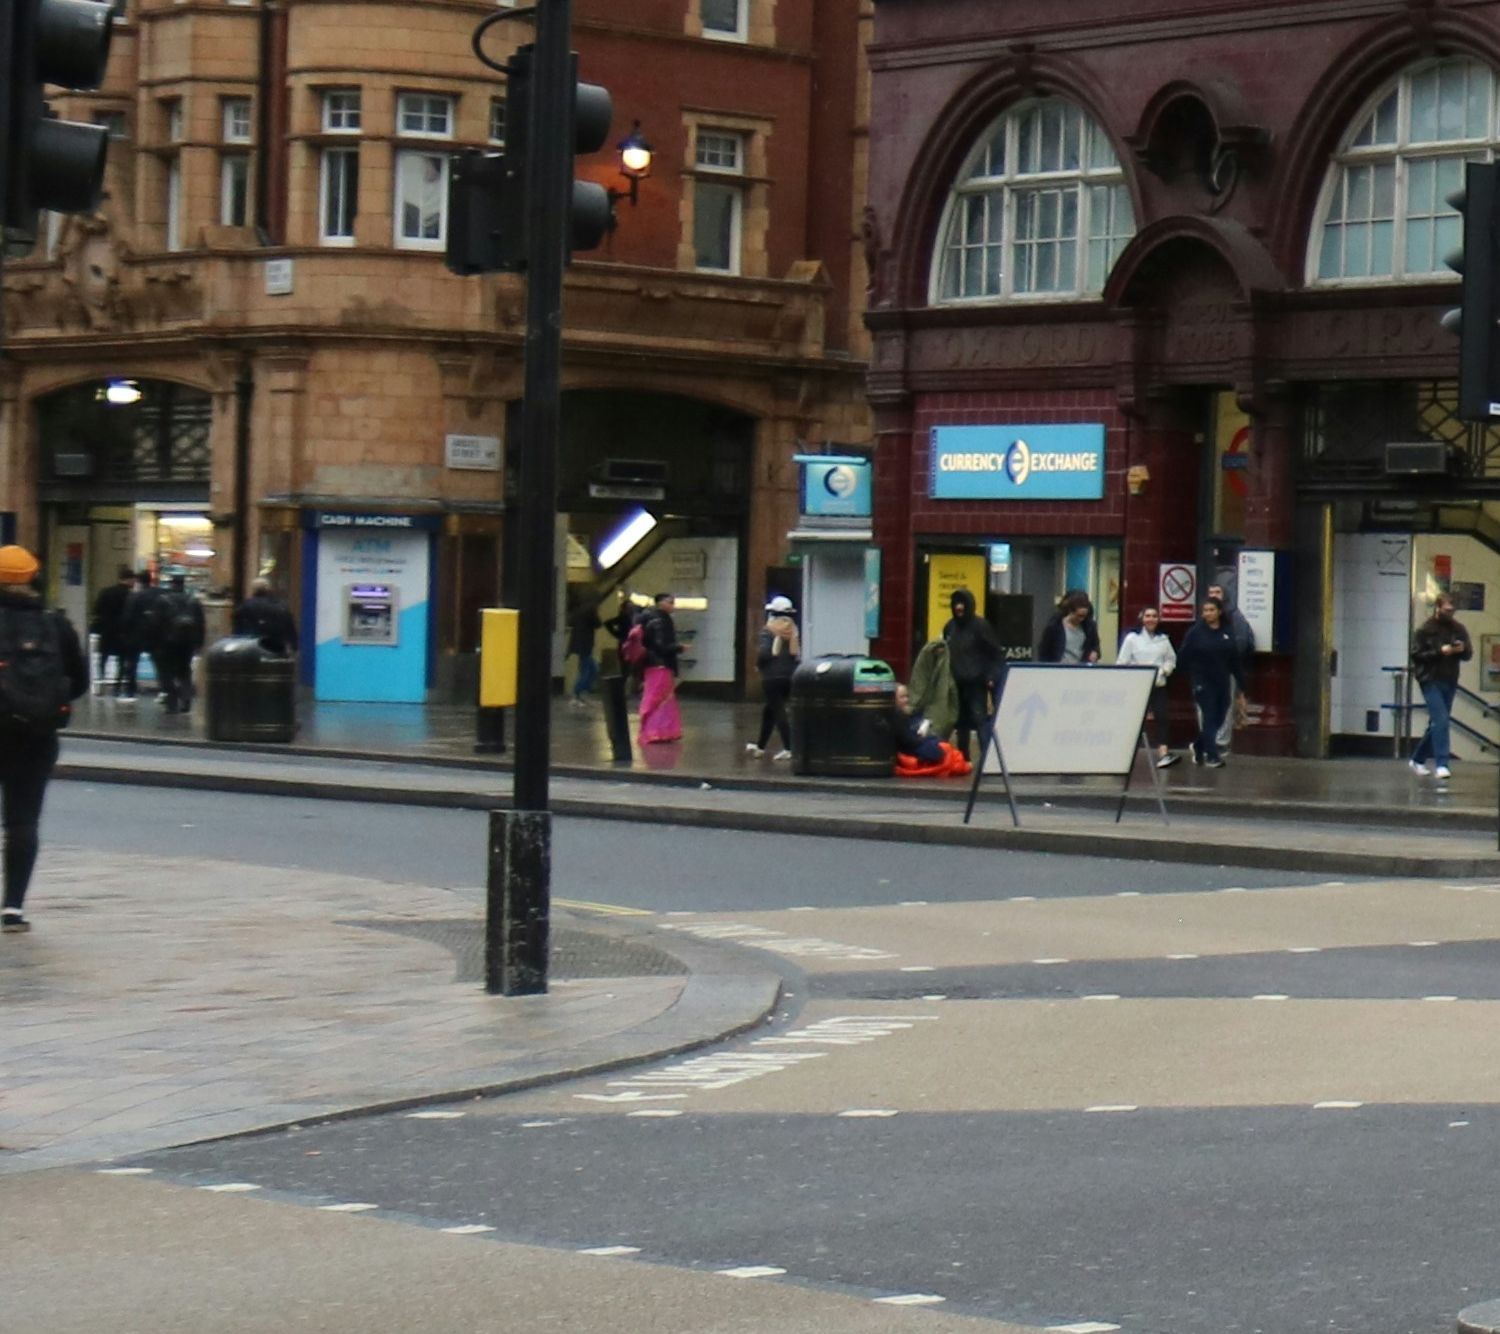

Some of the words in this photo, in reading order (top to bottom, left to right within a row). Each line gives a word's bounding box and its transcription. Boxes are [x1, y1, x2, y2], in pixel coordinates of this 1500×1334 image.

[1330, 311, 1434, 354] CIRC
[940, 453, 1005, 472] CURRENCY
[1030, 452, 1098, 472] EXCHANGE
[321, 514, 351, 525] CASH
[354, 515, 412, 527] MACHINE
[1001, 646, 1032, 659] ASH
